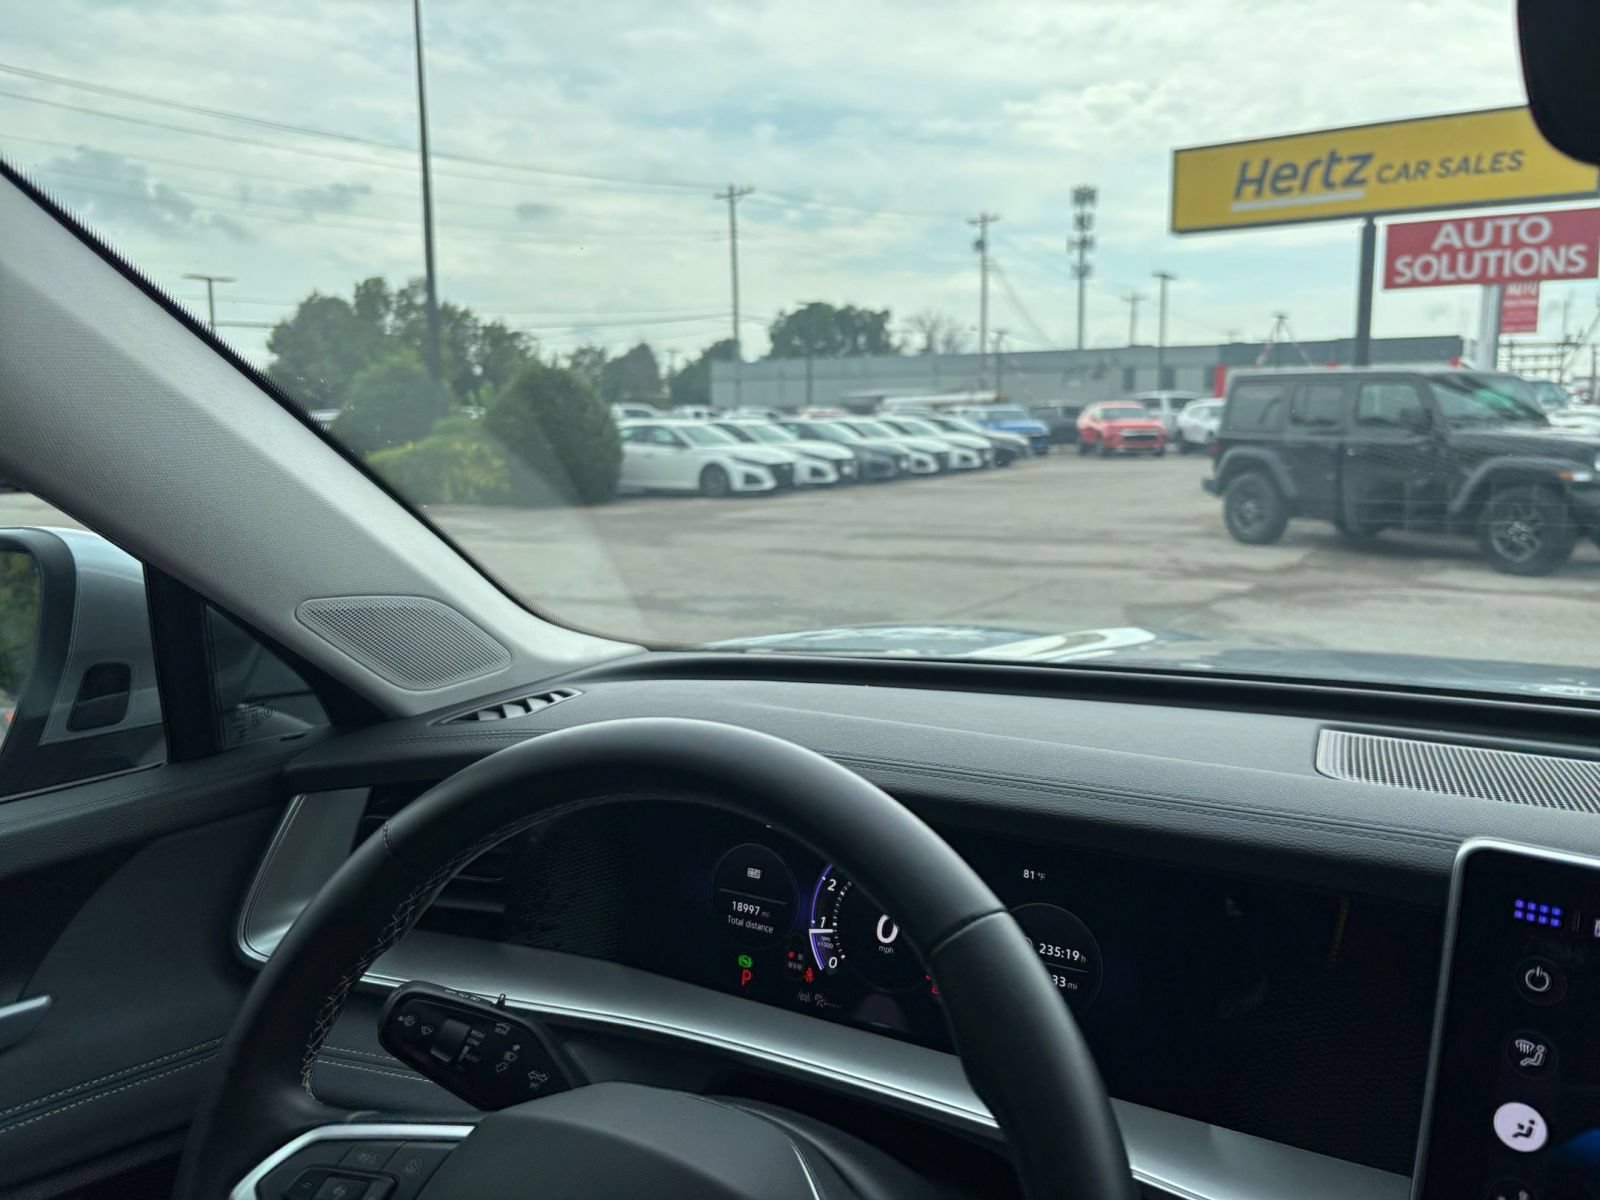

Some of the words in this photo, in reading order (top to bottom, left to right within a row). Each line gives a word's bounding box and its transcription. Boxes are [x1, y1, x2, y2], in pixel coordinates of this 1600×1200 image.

[1234, 148, 1374, 199] Hertz
[1376, 163, 1431, 185] CAR
[1436, 150, 1525, 178] SALES
[1431, 215, 1552, 252] AUTO
[1393, 244, 1589, 284] SOLUTIONS
[1023, 869, 1035, 879] 81
[827, 878, 837, 891] 2
[732, 901, 760, 915] 18997
[728, 915, 744, 926] Total
[745, 920, 774, 934] distance
[821, 916, 826, 928] 1
[876, 913, 899, 944] 0
[878, 945, 894, 955] mph
[1039, 943, 1080, 961] 235:19
[828, 956, 838, 969] 0
[741, 969, 752, 986] P
[1067, 981, 1078, 990] mi
